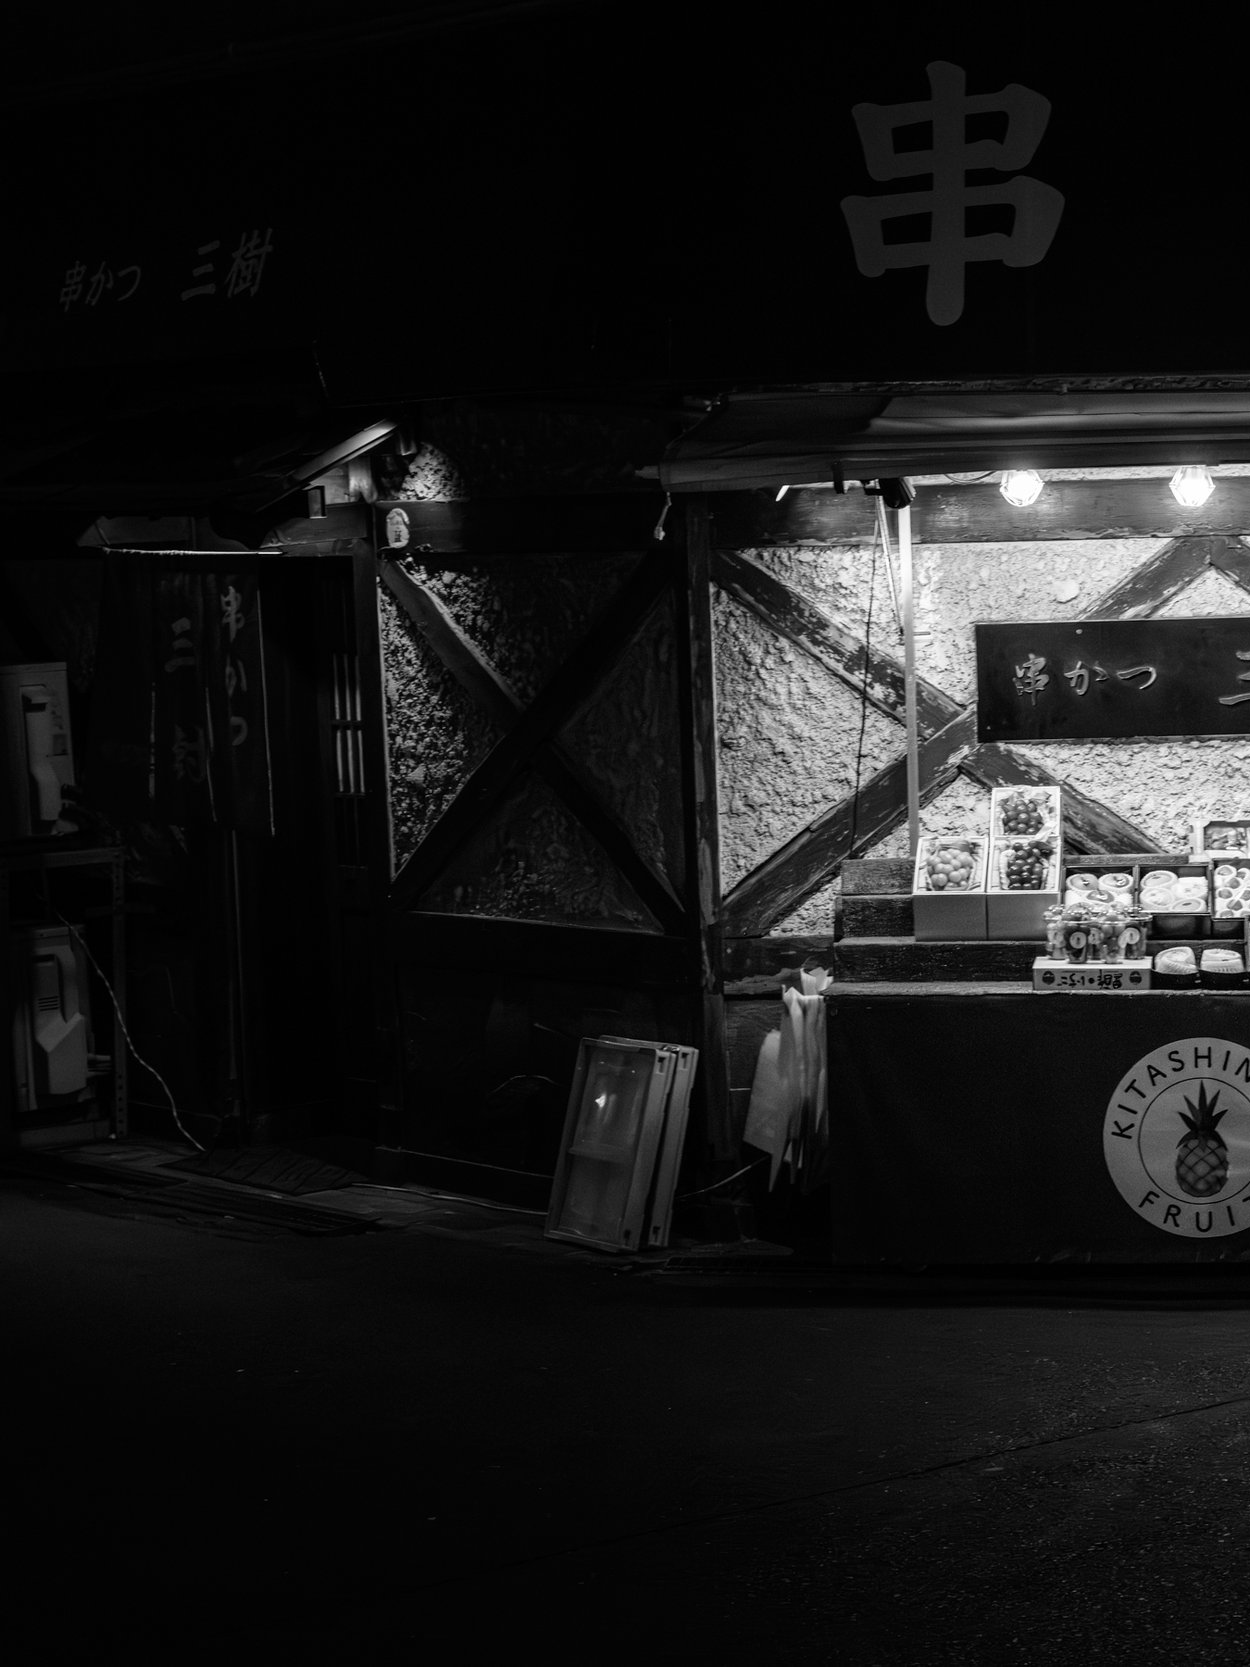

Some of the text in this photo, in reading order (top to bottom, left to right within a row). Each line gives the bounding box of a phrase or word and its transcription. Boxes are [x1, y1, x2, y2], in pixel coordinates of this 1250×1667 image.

[839, 60, 1066, 327] 串
[58, 226, 275, 313] 串かつ 三樹
[1012, 653, 1158, 706] 串かつ
